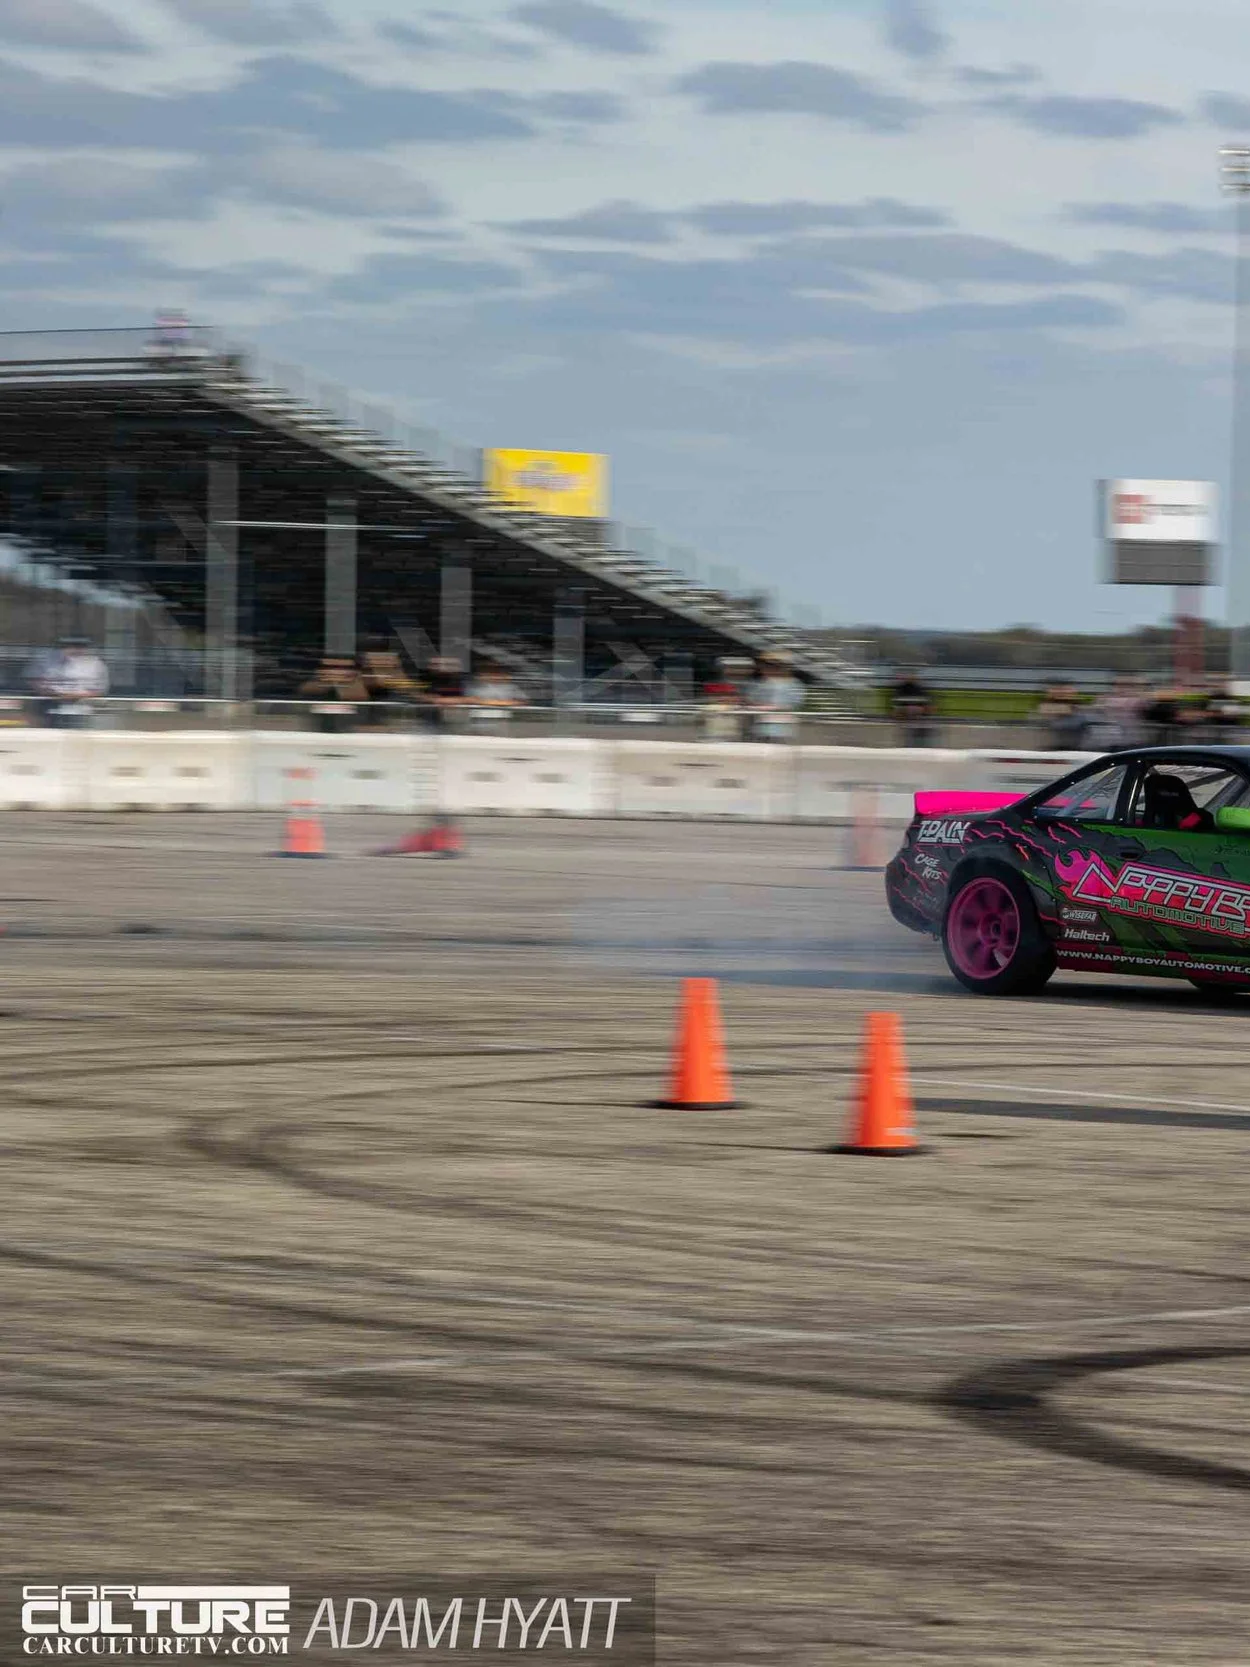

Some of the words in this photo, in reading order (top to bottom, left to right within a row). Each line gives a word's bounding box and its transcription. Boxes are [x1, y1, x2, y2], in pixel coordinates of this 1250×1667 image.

[914, 853, 940, 867] CAGE
[1109, 896, 1246, 935] AUTOMOTIVE
[1064, 928, 1110, 941] Haltech
